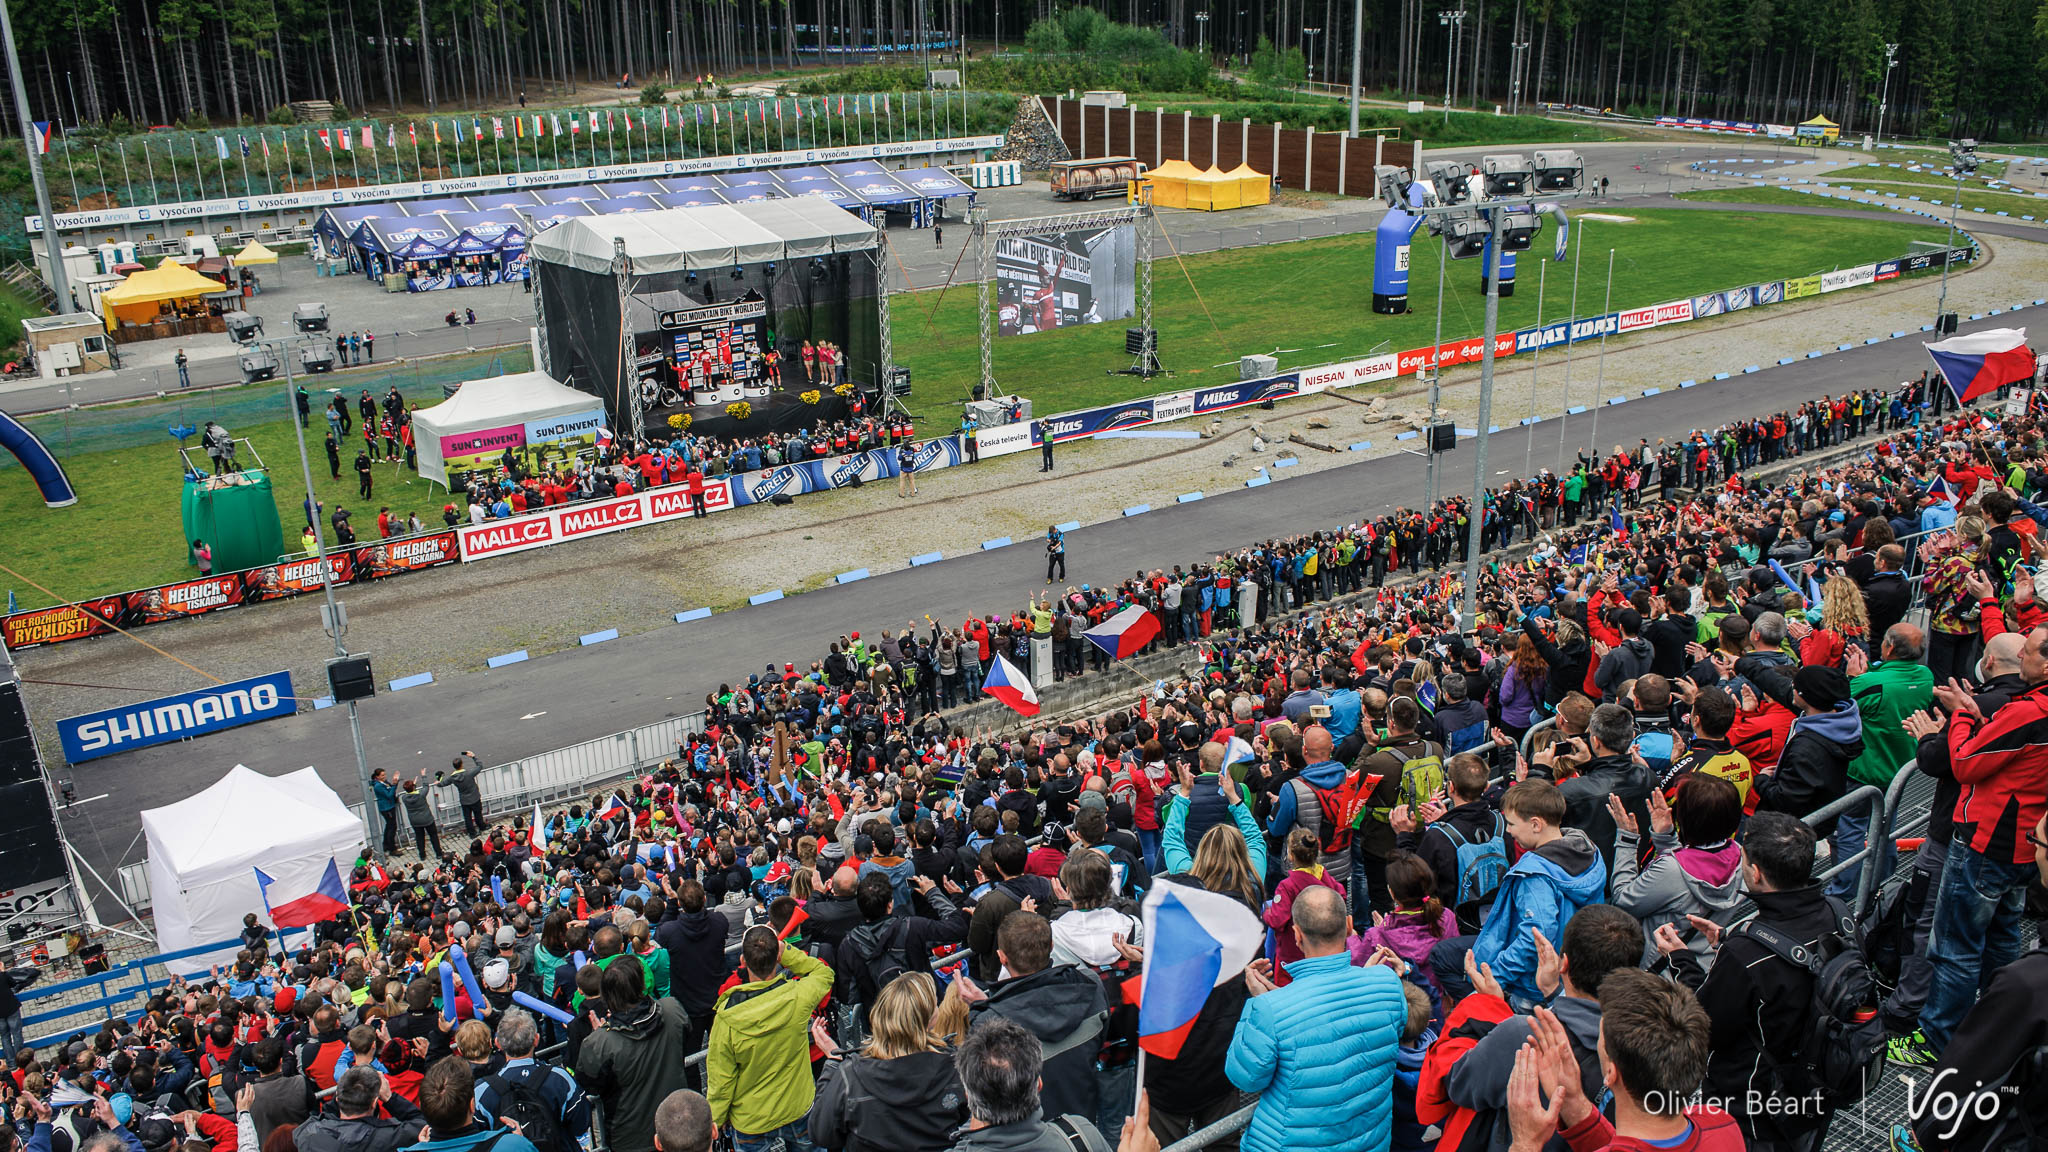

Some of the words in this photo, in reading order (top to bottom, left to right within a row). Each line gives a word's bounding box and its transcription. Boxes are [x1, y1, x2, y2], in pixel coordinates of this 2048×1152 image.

[885, 143, 913, 155] Vysočina
[948, 138, 974, 149] Vysočina
[751, 154, 782, 165] Vysočina
[820, 149, 849, 159] Vysočina
[604, 167, 637, 178] Vysočina
[679, 160, 711, 171] Vysočina
[440, 179, 477, 191] Vysočina
[524, 173, 559, 184] Vysočina
[351, 188, 390, 199] Vysočina
[160, 206, 202, 217] Vysočina
[258, 197, 299, 209] Vysočina
[55, 215, 101, 227] Vysočina
[997, 239, 1029, 260] NTAIN
[1031, 244, 1049, 264] BIKE
[1078, 257, 1091, 275] CUP
[1911, 257, 1930, 265] GoPro
[677, 313, 688, 323] UCI
[689, 308, 719, 321] MOUNTAIN
[720, 307, 733, 317] BIKE
[734, 304, 754, 315] WORLD
[755, 302, 766, 312] CUP
[1621, 310, 1654, 328] MALL.CZ
[1658, 304, 1690, 321] MALL.CZ
[1306, 370, 1345, 387] NISSAN
[1354, 360, 1392, 377] NISSAN
[1199, 390, 1240, 408] Mitas
[536, 427, 555, 438] SUN
[565, 418, 599, 433] INVENT
[451, 441, 472, 452] SUN
[483, 433, 519, 446] INVENT
[1001, 433, 1028, 444] televize
[832, 455, 869, 486] BIRELL
[753, 468, 793, 500] BIRELL
[565, 500, 640, 531] MALL.CZ
[470, 521, 549, 552] MALL.CZ
[392, 539, 439, 560] HELBICH
[169, 581, 220, 604] HELBICH
[9, 620, 27, 630] KDE
[30, 609, 79, 627] ROZHODUJE
[14, 617, 89, 643] RYCHLOST!
[77, 683, 279, 752] SHIMANO
